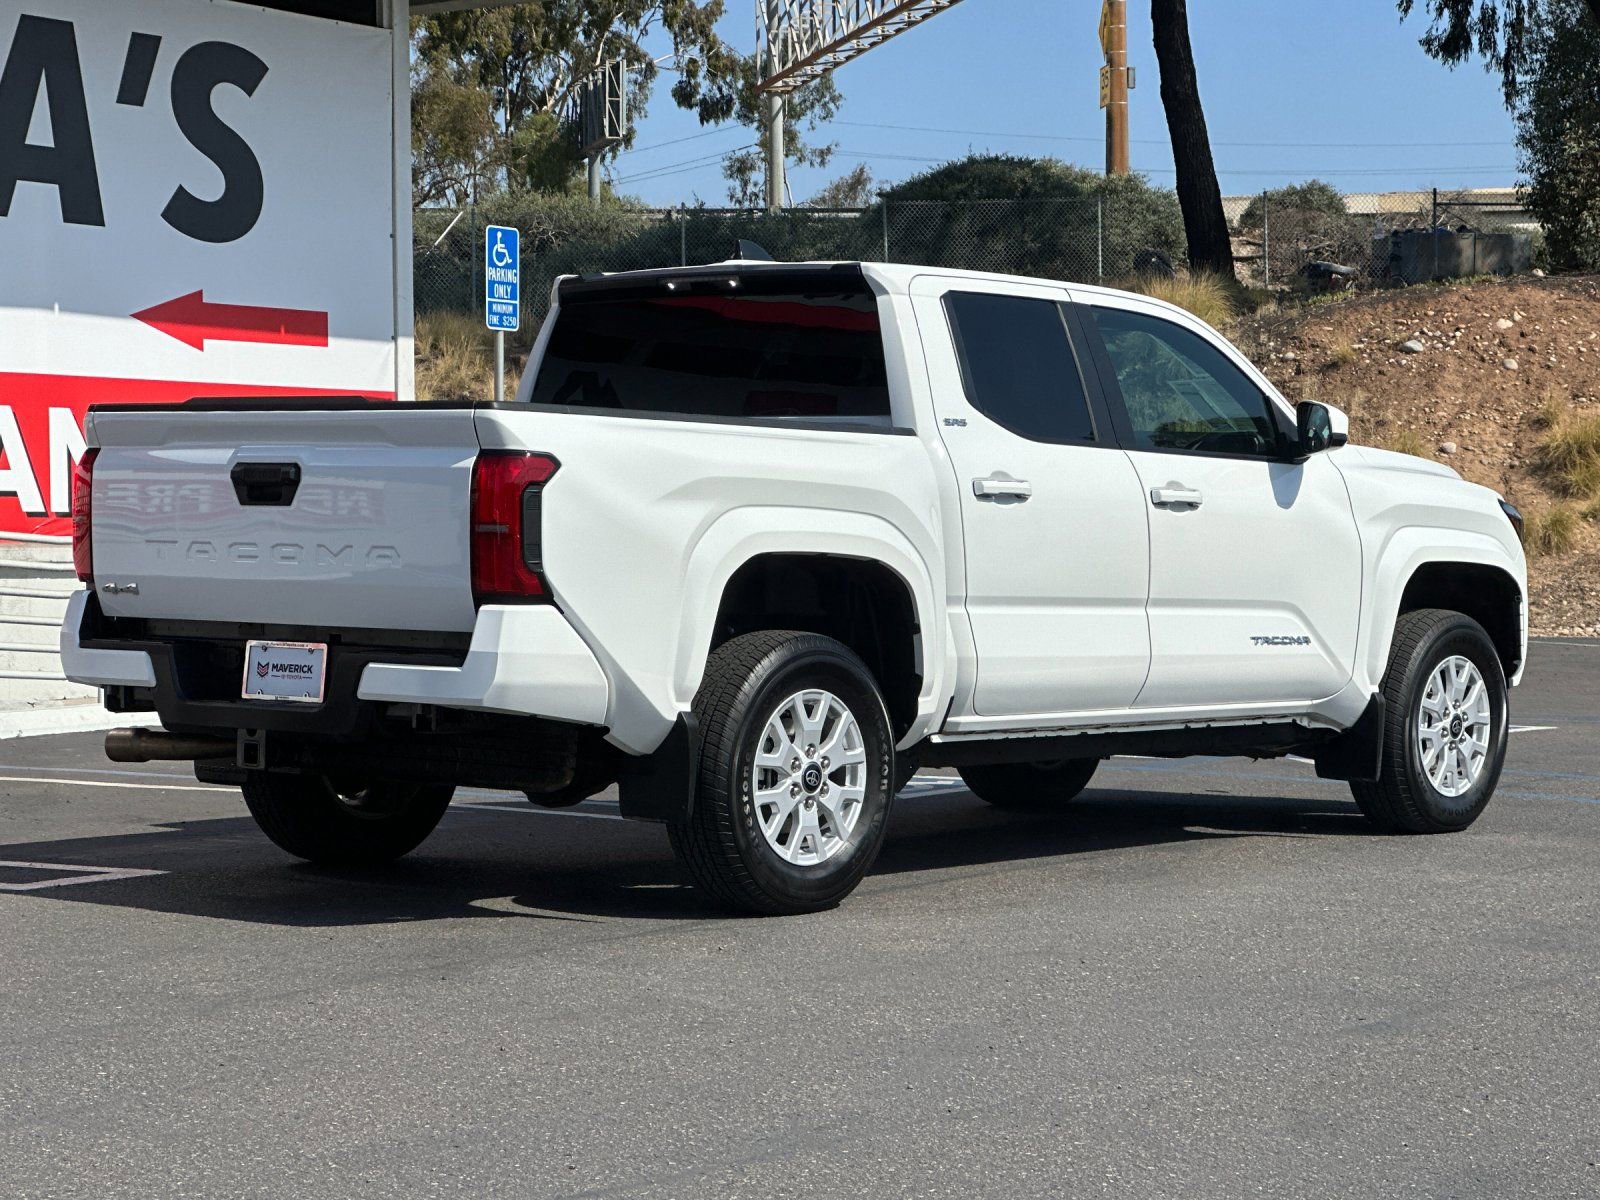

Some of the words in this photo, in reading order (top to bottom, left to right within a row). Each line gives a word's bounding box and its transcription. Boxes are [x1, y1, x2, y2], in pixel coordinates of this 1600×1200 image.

[488, 267, 517, 283] PARKING
[494, 284, 511, 299] ONLY
[492, 303, 513, 314] MINIMUM
[489, 314, 500, 325] FINE
[502, 316, 517, 327] $250
[144, 539, 402, 569] TACOMA
[1249, 635, 1312, 647] TACOMA
[271, 663, 314, 674] MAVERICK
